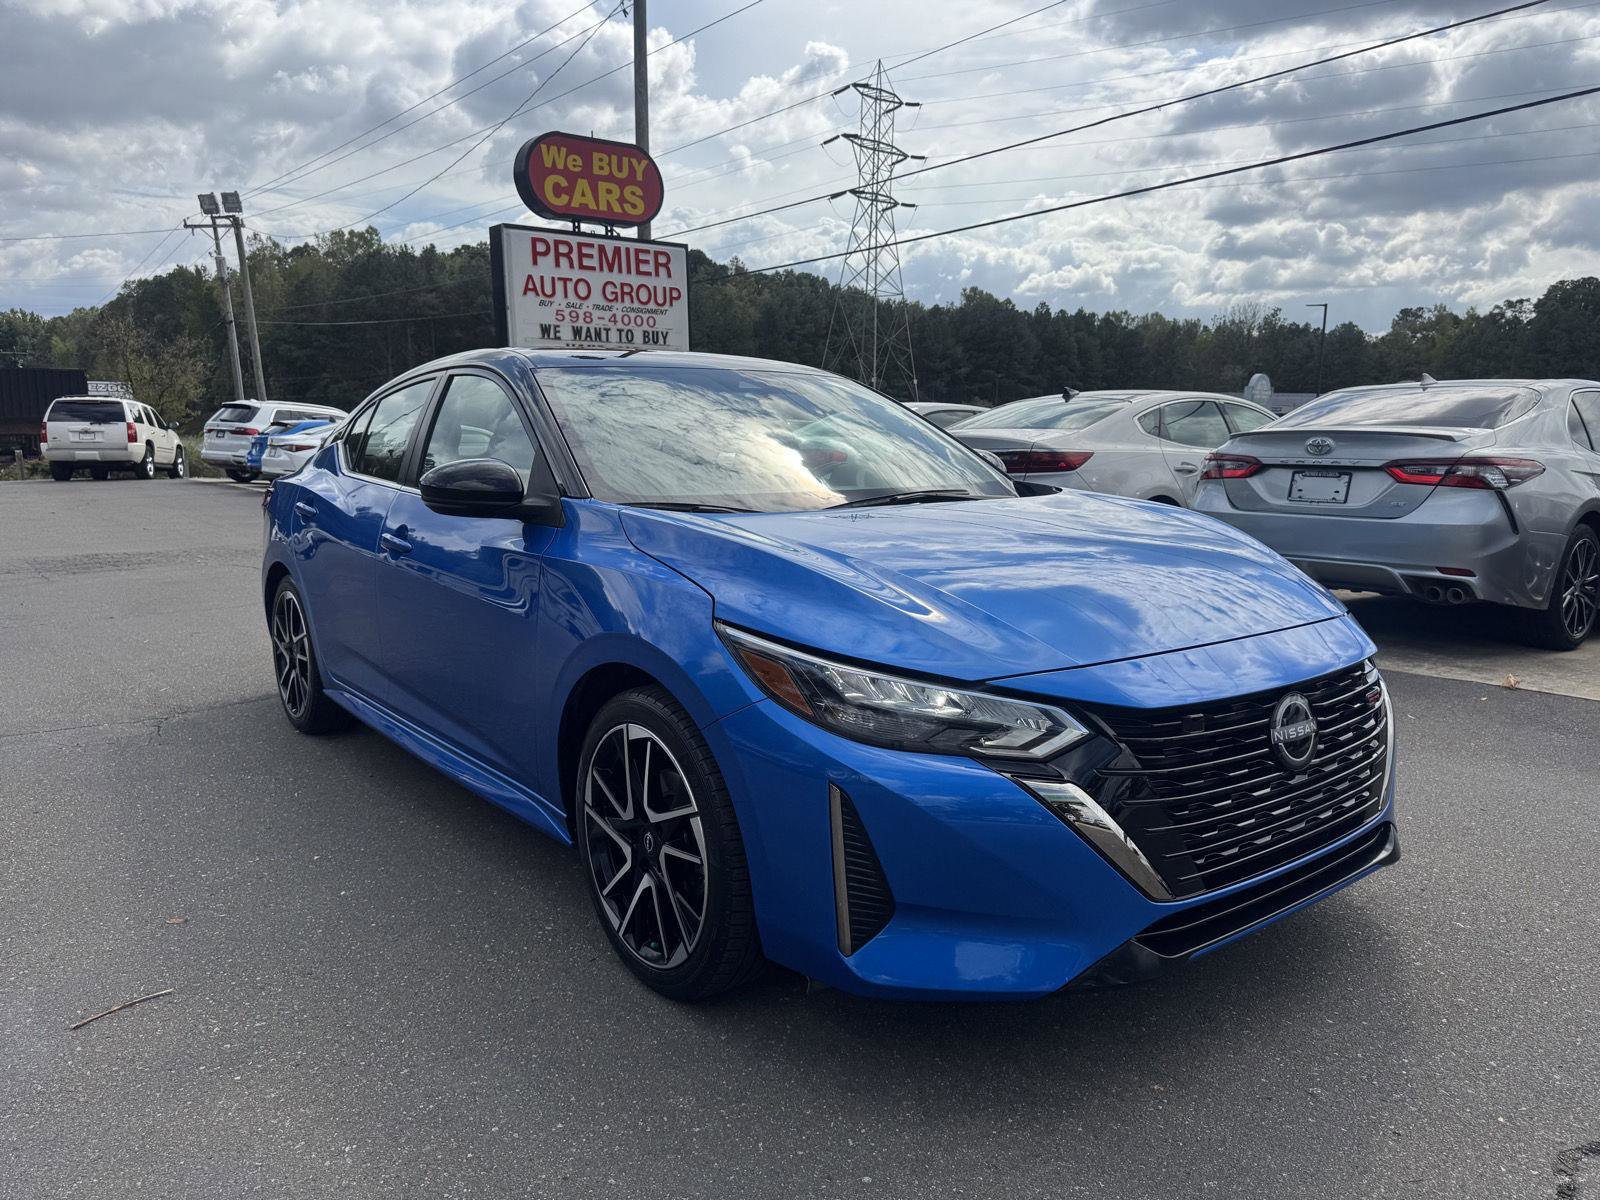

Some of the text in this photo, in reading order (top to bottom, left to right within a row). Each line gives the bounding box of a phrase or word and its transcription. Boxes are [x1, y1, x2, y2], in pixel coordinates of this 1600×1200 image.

[540, 143, 649, 181] We BUY
[543, 174, 645, 216] CARS
[530, 236, 672, 278] PREMIER
[522, 273, 682, 308] AUTO GROUP
[538, 299, 669, 316] BUY SALE TRADE CONSIGNMENT
[555, 309, 657, 328] 598-4000
[540, 323, 669, 345] WE WANT TO BUY
[1273, 721, 1317, 742] NISSAN
